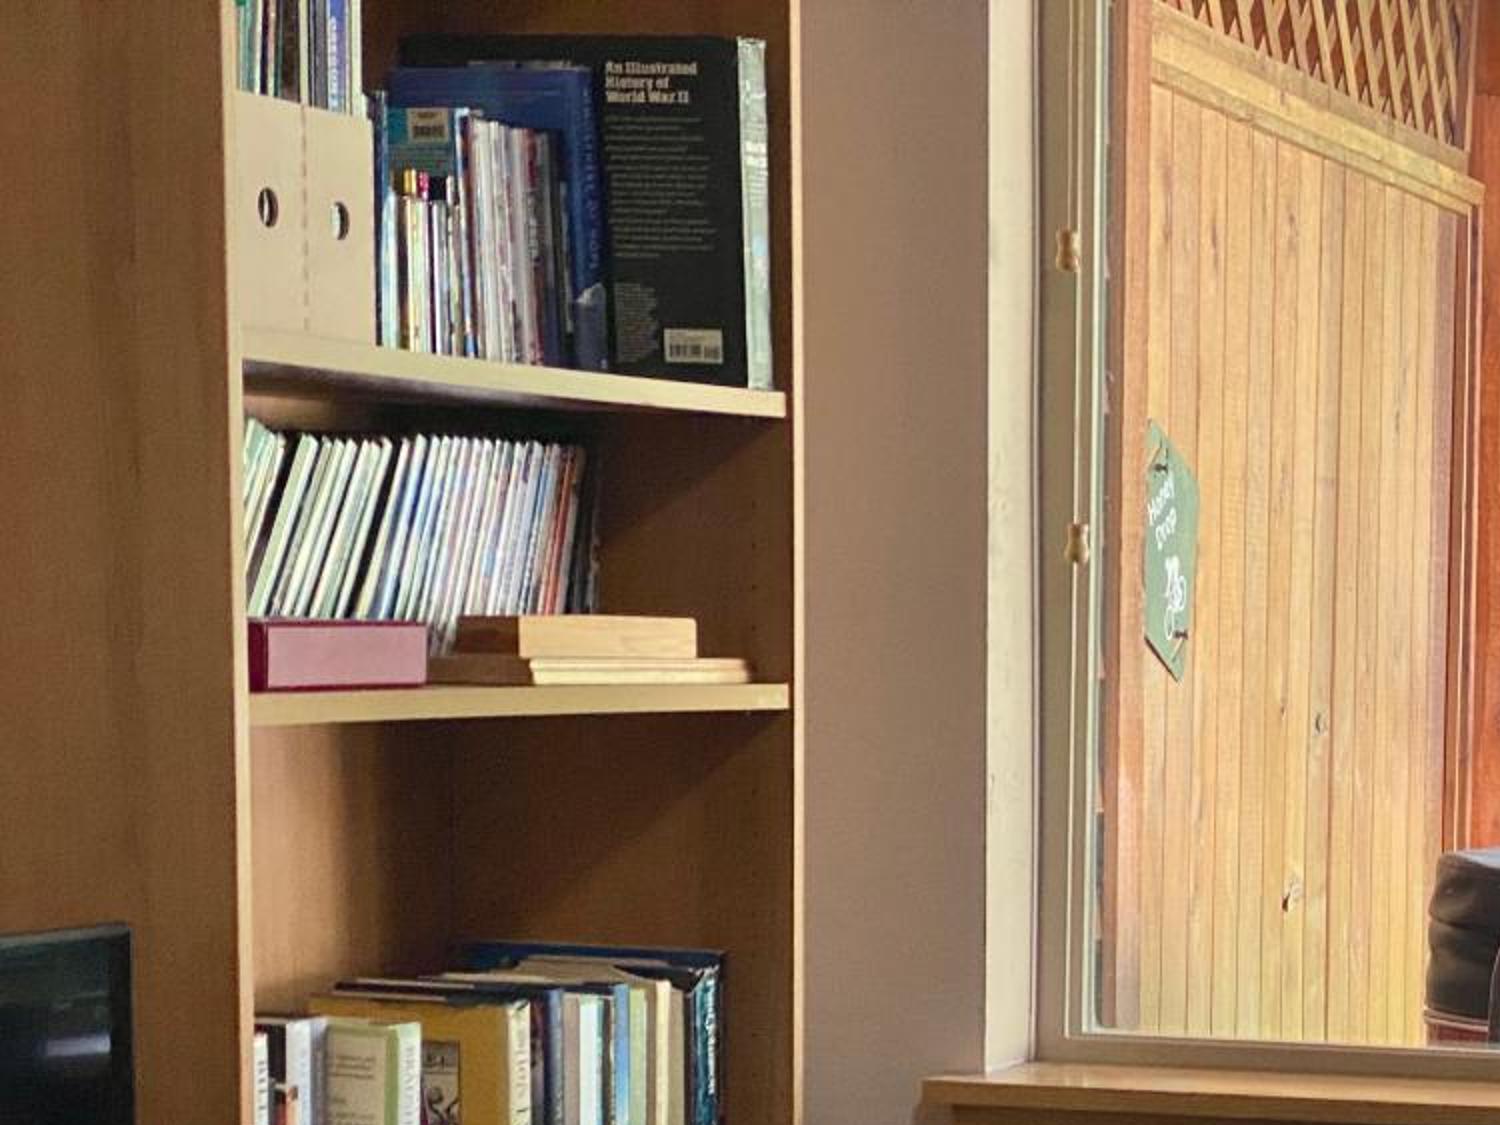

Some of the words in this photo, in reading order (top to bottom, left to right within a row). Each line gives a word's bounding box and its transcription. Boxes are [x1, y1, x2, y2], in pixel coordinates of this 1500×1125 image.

[605, 61, 623, 75] An
[625, 61, 698, 76] Illustrated
[605, 77, 653, 91] History
[655, 77, 671, 89] of
[605, 90, 646, 104] World
[647, 90, 676, 104] War
[677, 90, 690, 104] II
